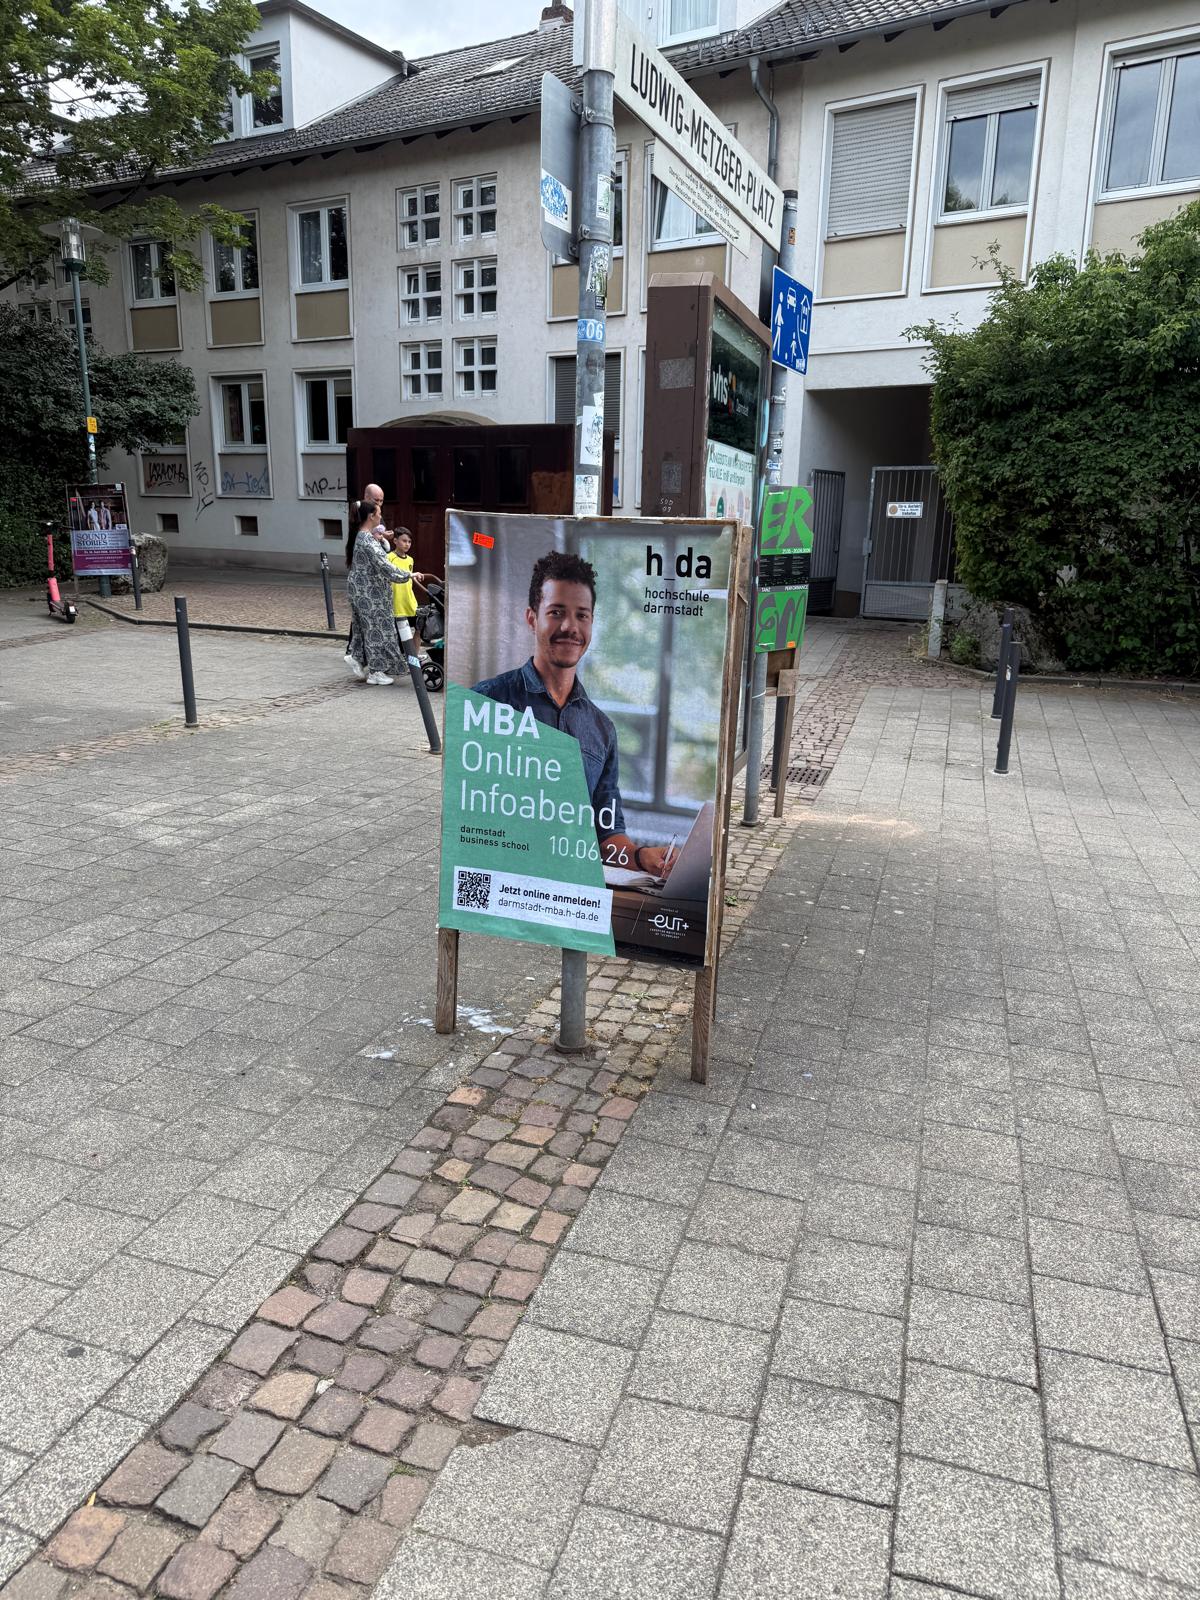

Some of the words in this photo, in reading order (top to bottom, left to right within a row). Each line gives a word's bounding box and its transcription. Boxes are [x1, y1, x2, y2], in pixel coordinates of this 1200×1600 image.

[630, 43, 775, 229] LUDWIG-METZGER-PLATZ
[586, 321, 603, 341] 06
[712, 364, 729, 406] vhs
[77, 532, 107, 542] SOUND
[77, 539, 108, 547] STORIES
[645, 545, 712, 581] h_da
[644, 588, 710, 604] hochschule
[642, 602, 704, 618] darmstadt
[463, 699, 540, 740] MBA
[461, 741, 562, 782] Online
[460, 780, 617, 831] Infoabend
[460, 825, 506, 838] darmstadt
[460, 835, 500, 848] business
[501, 840, 530, 852] school
[549, 835, 629, 866] 10.06.26
[499, 884, 522, 897] Jetzt
[523, 888, 551, 901] online
[552, 893, 601, 909] anmelden!
[498, 897, 599, 923] darmstadt-mba.h-da.de
